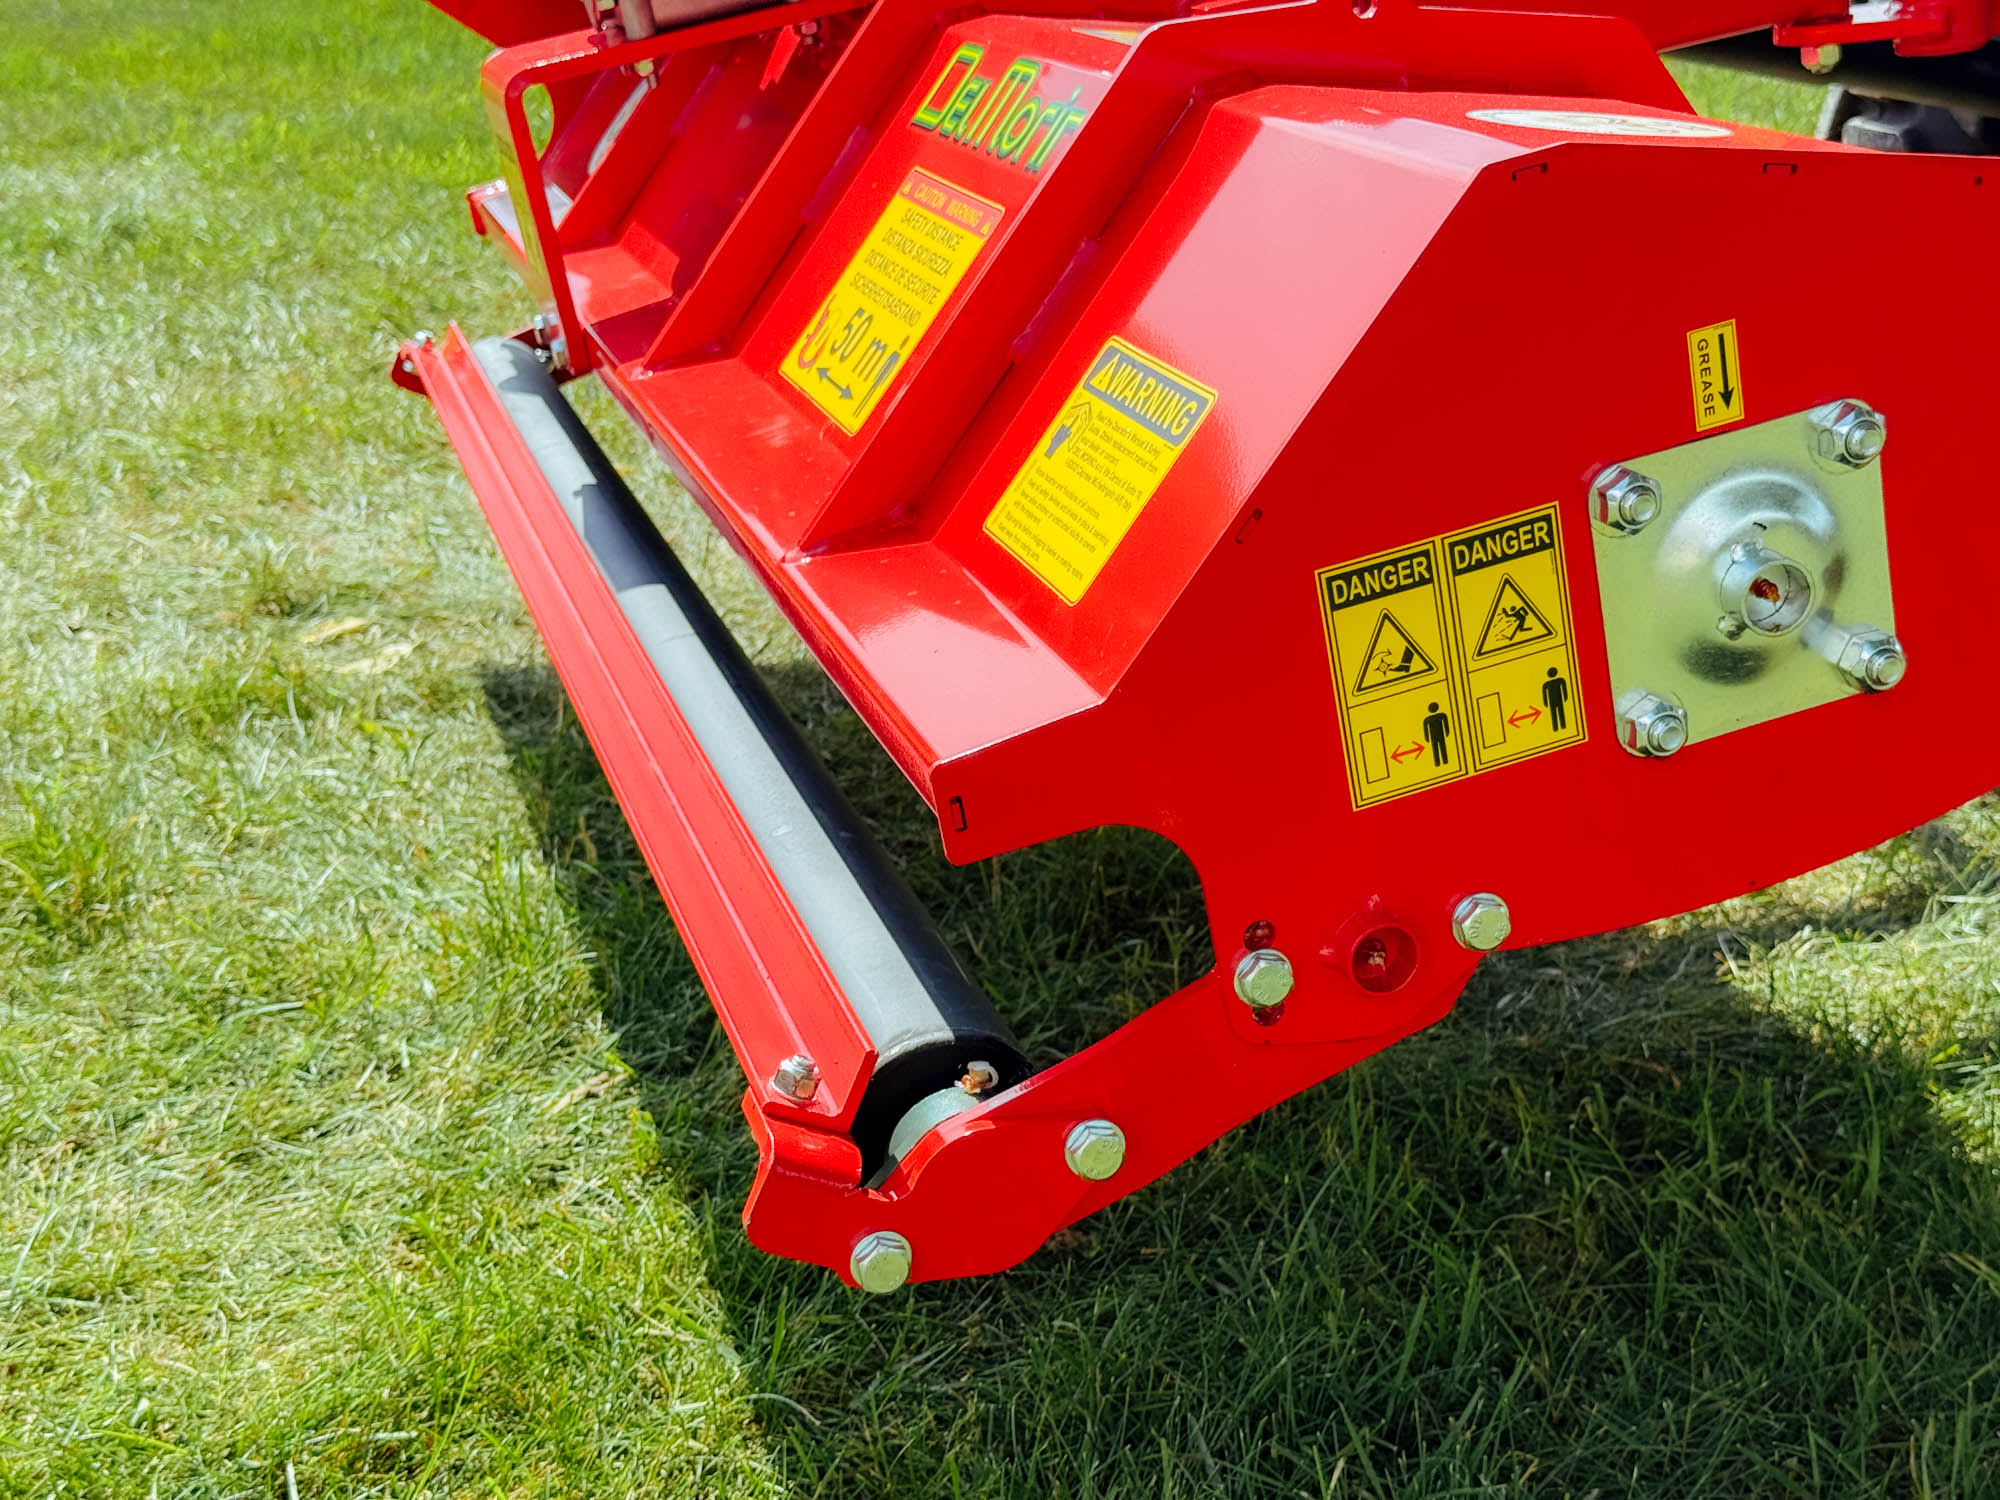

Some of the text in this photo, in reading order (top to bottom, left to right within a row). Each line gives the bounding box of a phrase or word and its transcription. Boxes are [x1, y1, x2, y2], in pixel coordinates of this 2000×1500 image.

[899, 207, 964, 252] SAFETY DISTANCE
[911, 182, 985, 228] CAUTION WARNING
[863, 247, 941, 305] DISTANCE DE SECURITE
[881, 226, 954, 278] DISTANZA SICUREZZA
[848, 271, 922, 328] SICHERHEITSABSTAND
[829, 307, 889, 382] 50 m
[1109, 362, 1197, 436] WARNING
[1697, 338, 1715, 418] GREASE
[1454, 520, 1550, 571] DANGER
[1331, 556, 1430, 604] DANGER
